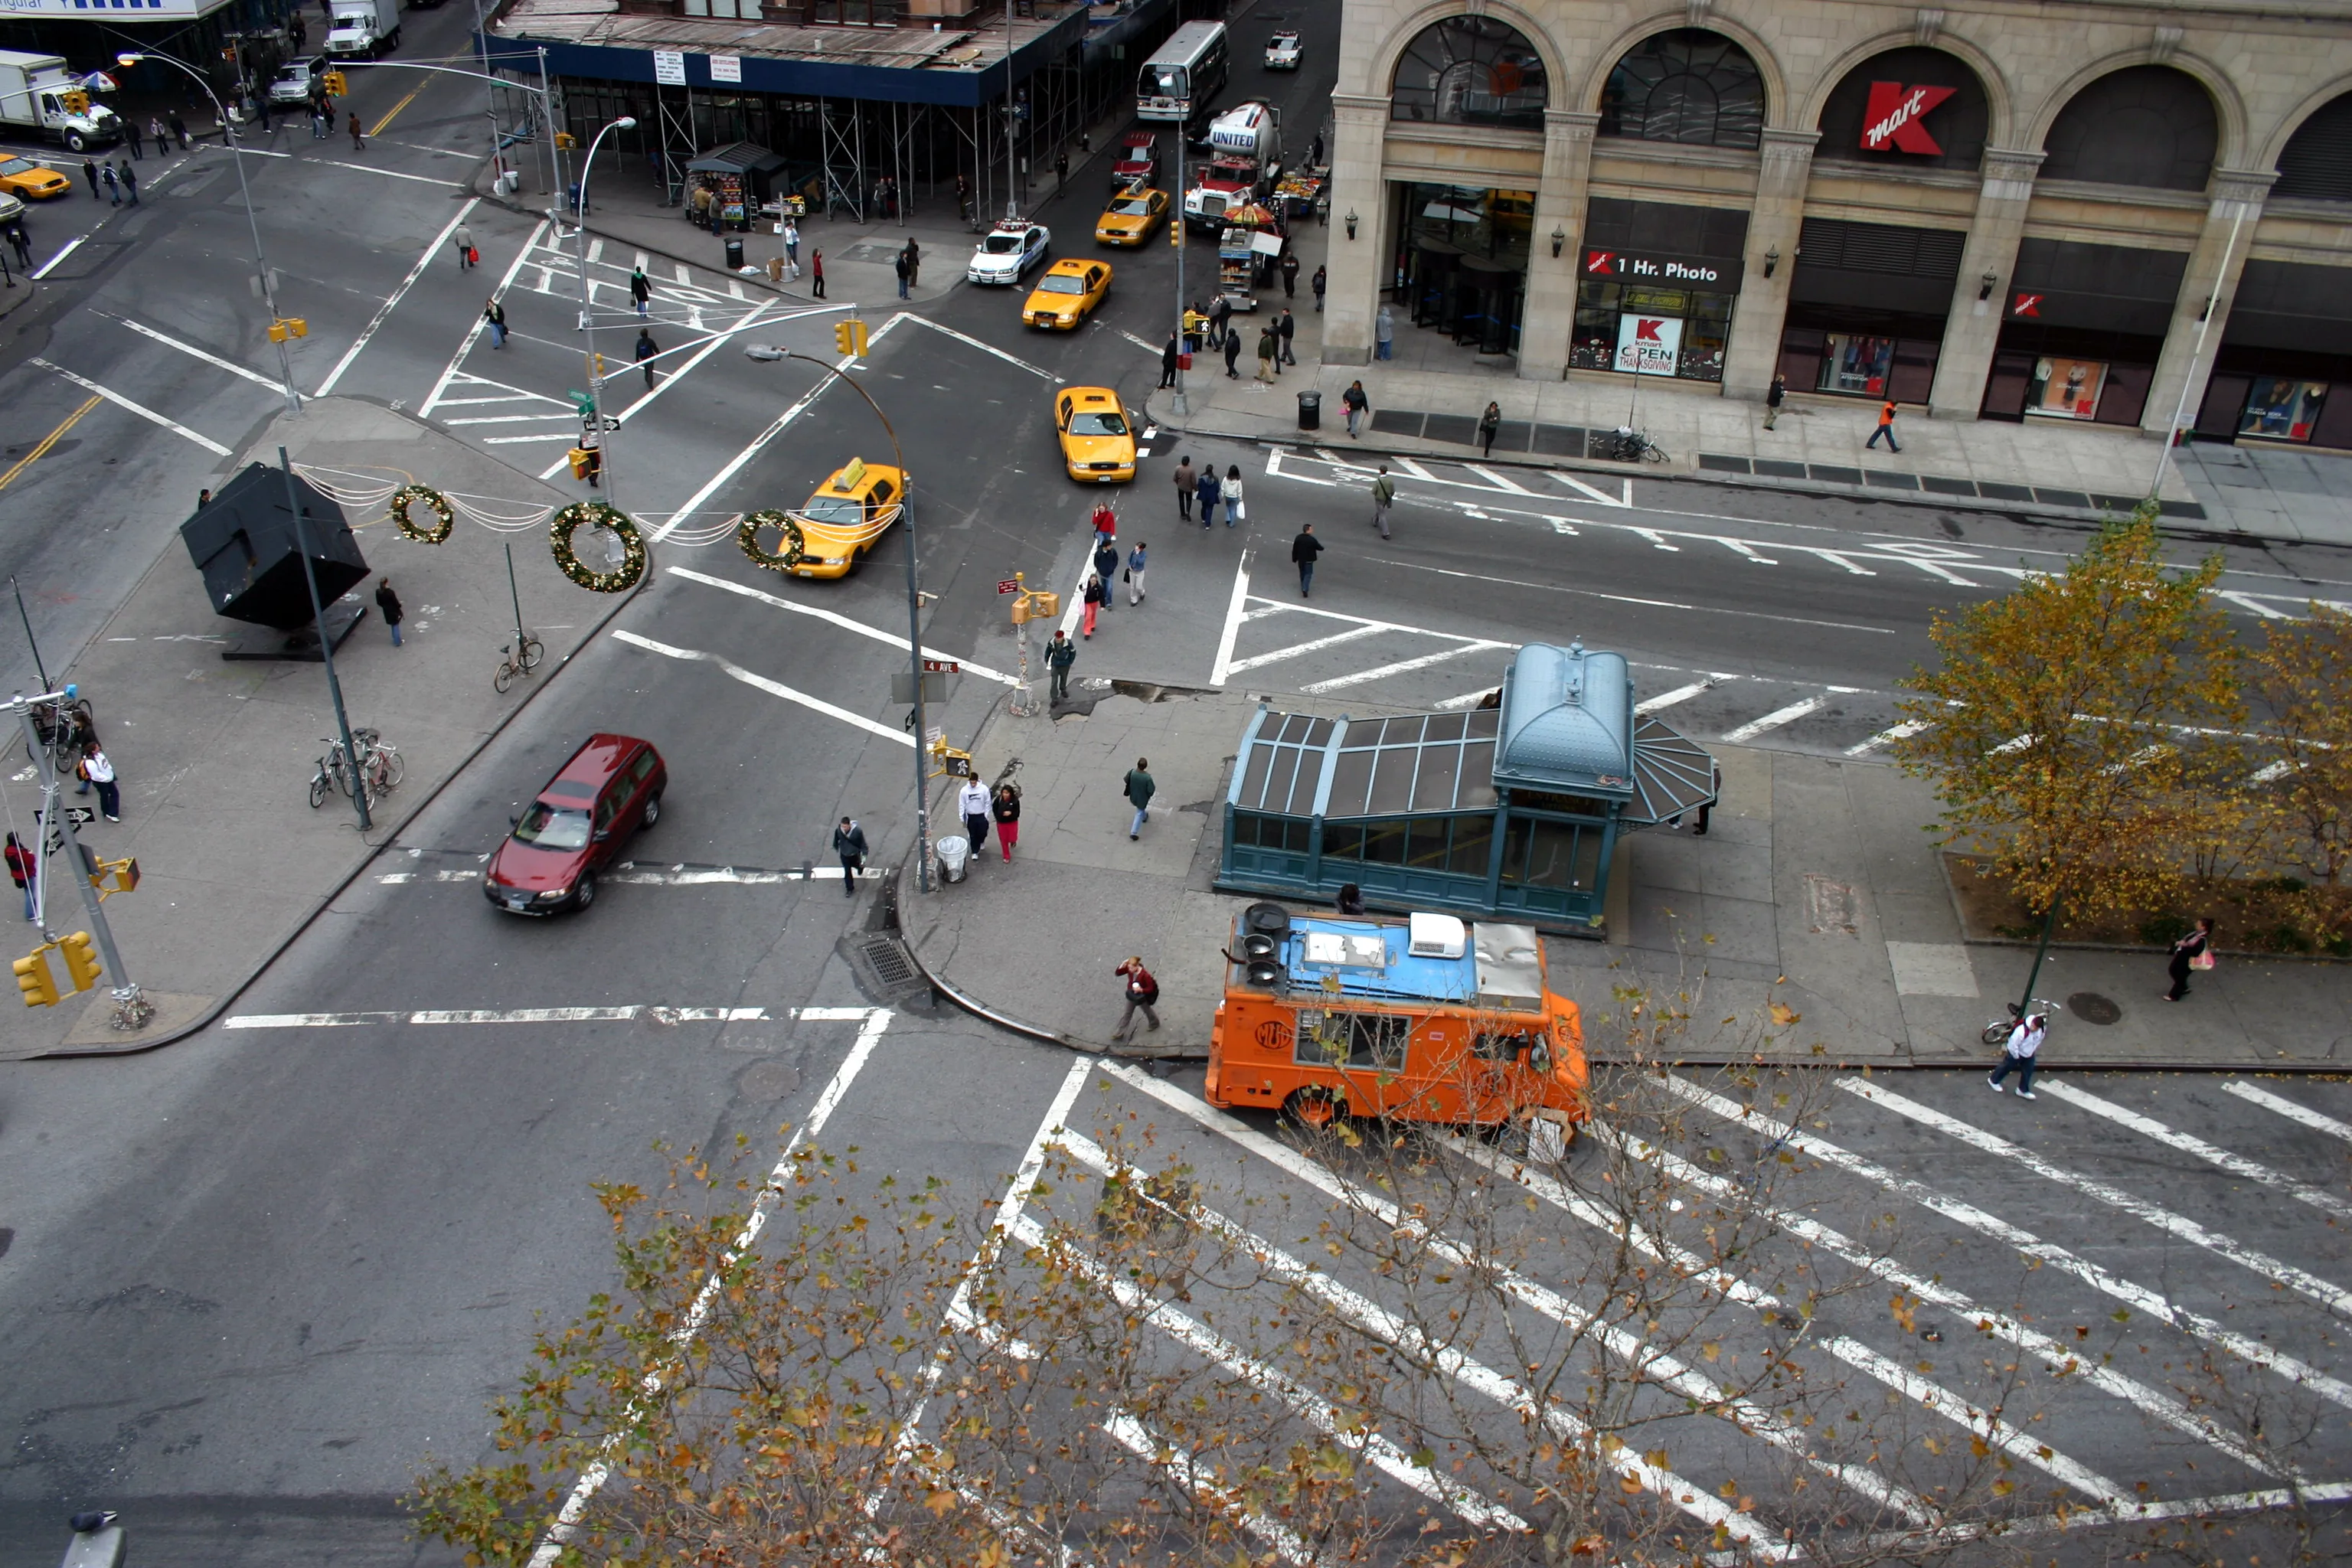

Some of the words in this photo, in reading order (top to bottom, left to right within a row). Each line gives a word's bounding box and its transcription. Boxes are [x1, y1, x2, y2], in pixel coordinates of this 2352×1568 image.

[1213, 131, 1254, 148] UNITED
[1619, 258, 1626, 273] 1
[1633, 260, 1658, 276] Hr.
[1665, 263, 1717, 282] Photo
[1636, 318, 1665, 341] K
[1622, 346, 1673, 361] OPEN
[1619, 357, 1672, 371] THANKSGIVING
[929, 662, 935, 671] 4
[939, 662, 953, 673] AVE
[1256, 1022, 1292, 1048] MUD
